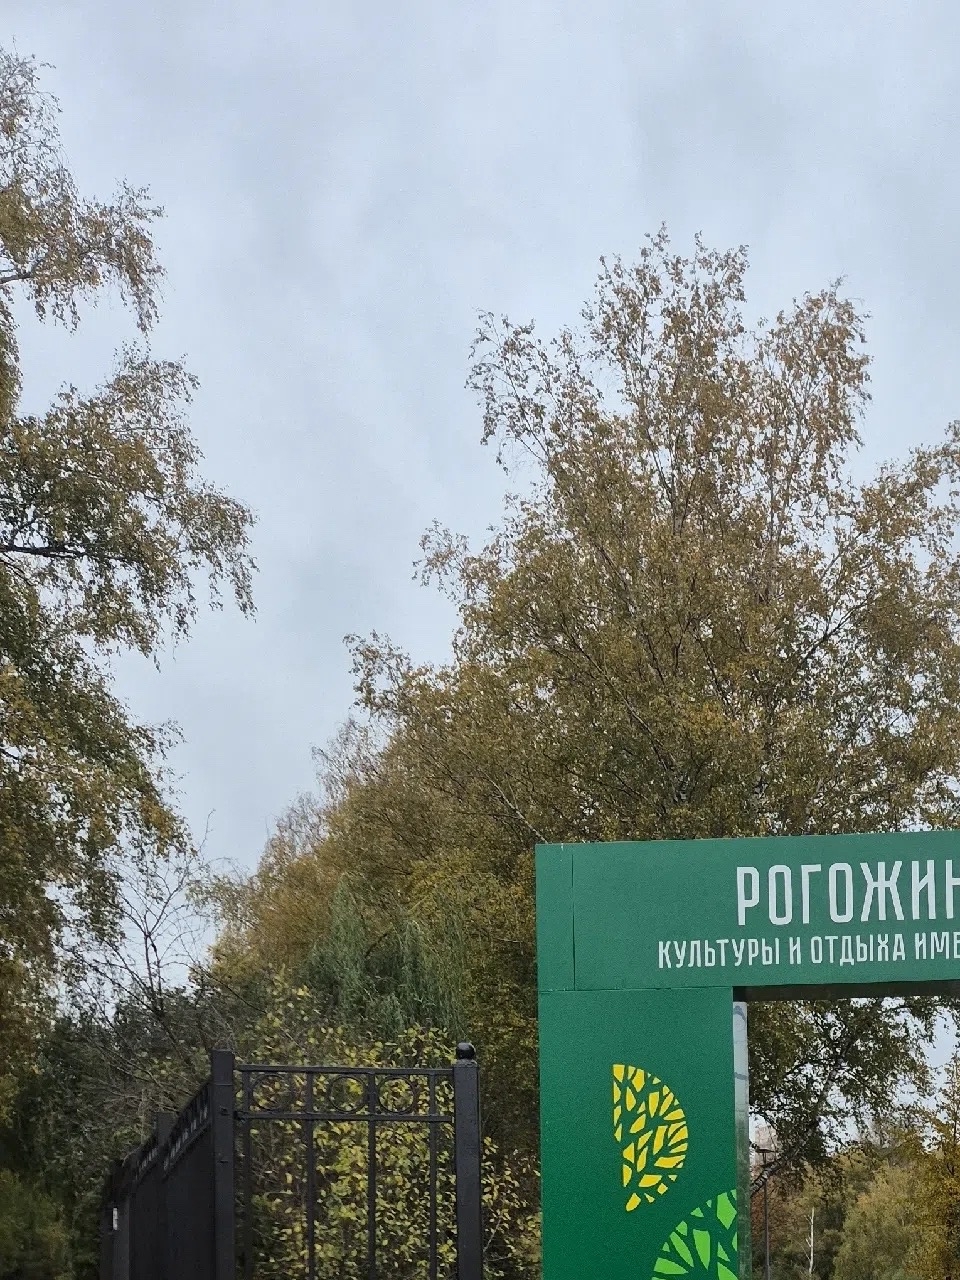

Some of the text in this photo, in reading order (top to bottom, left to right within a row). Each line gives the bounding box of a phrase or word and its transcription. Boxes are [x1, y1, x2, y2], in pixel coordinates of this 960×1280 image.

[658, 937, 780, 969] КУЛЬТУРЫ
[789, 936, 802, 965] И
[810, 933, 906, 967] ОТДЫХА
